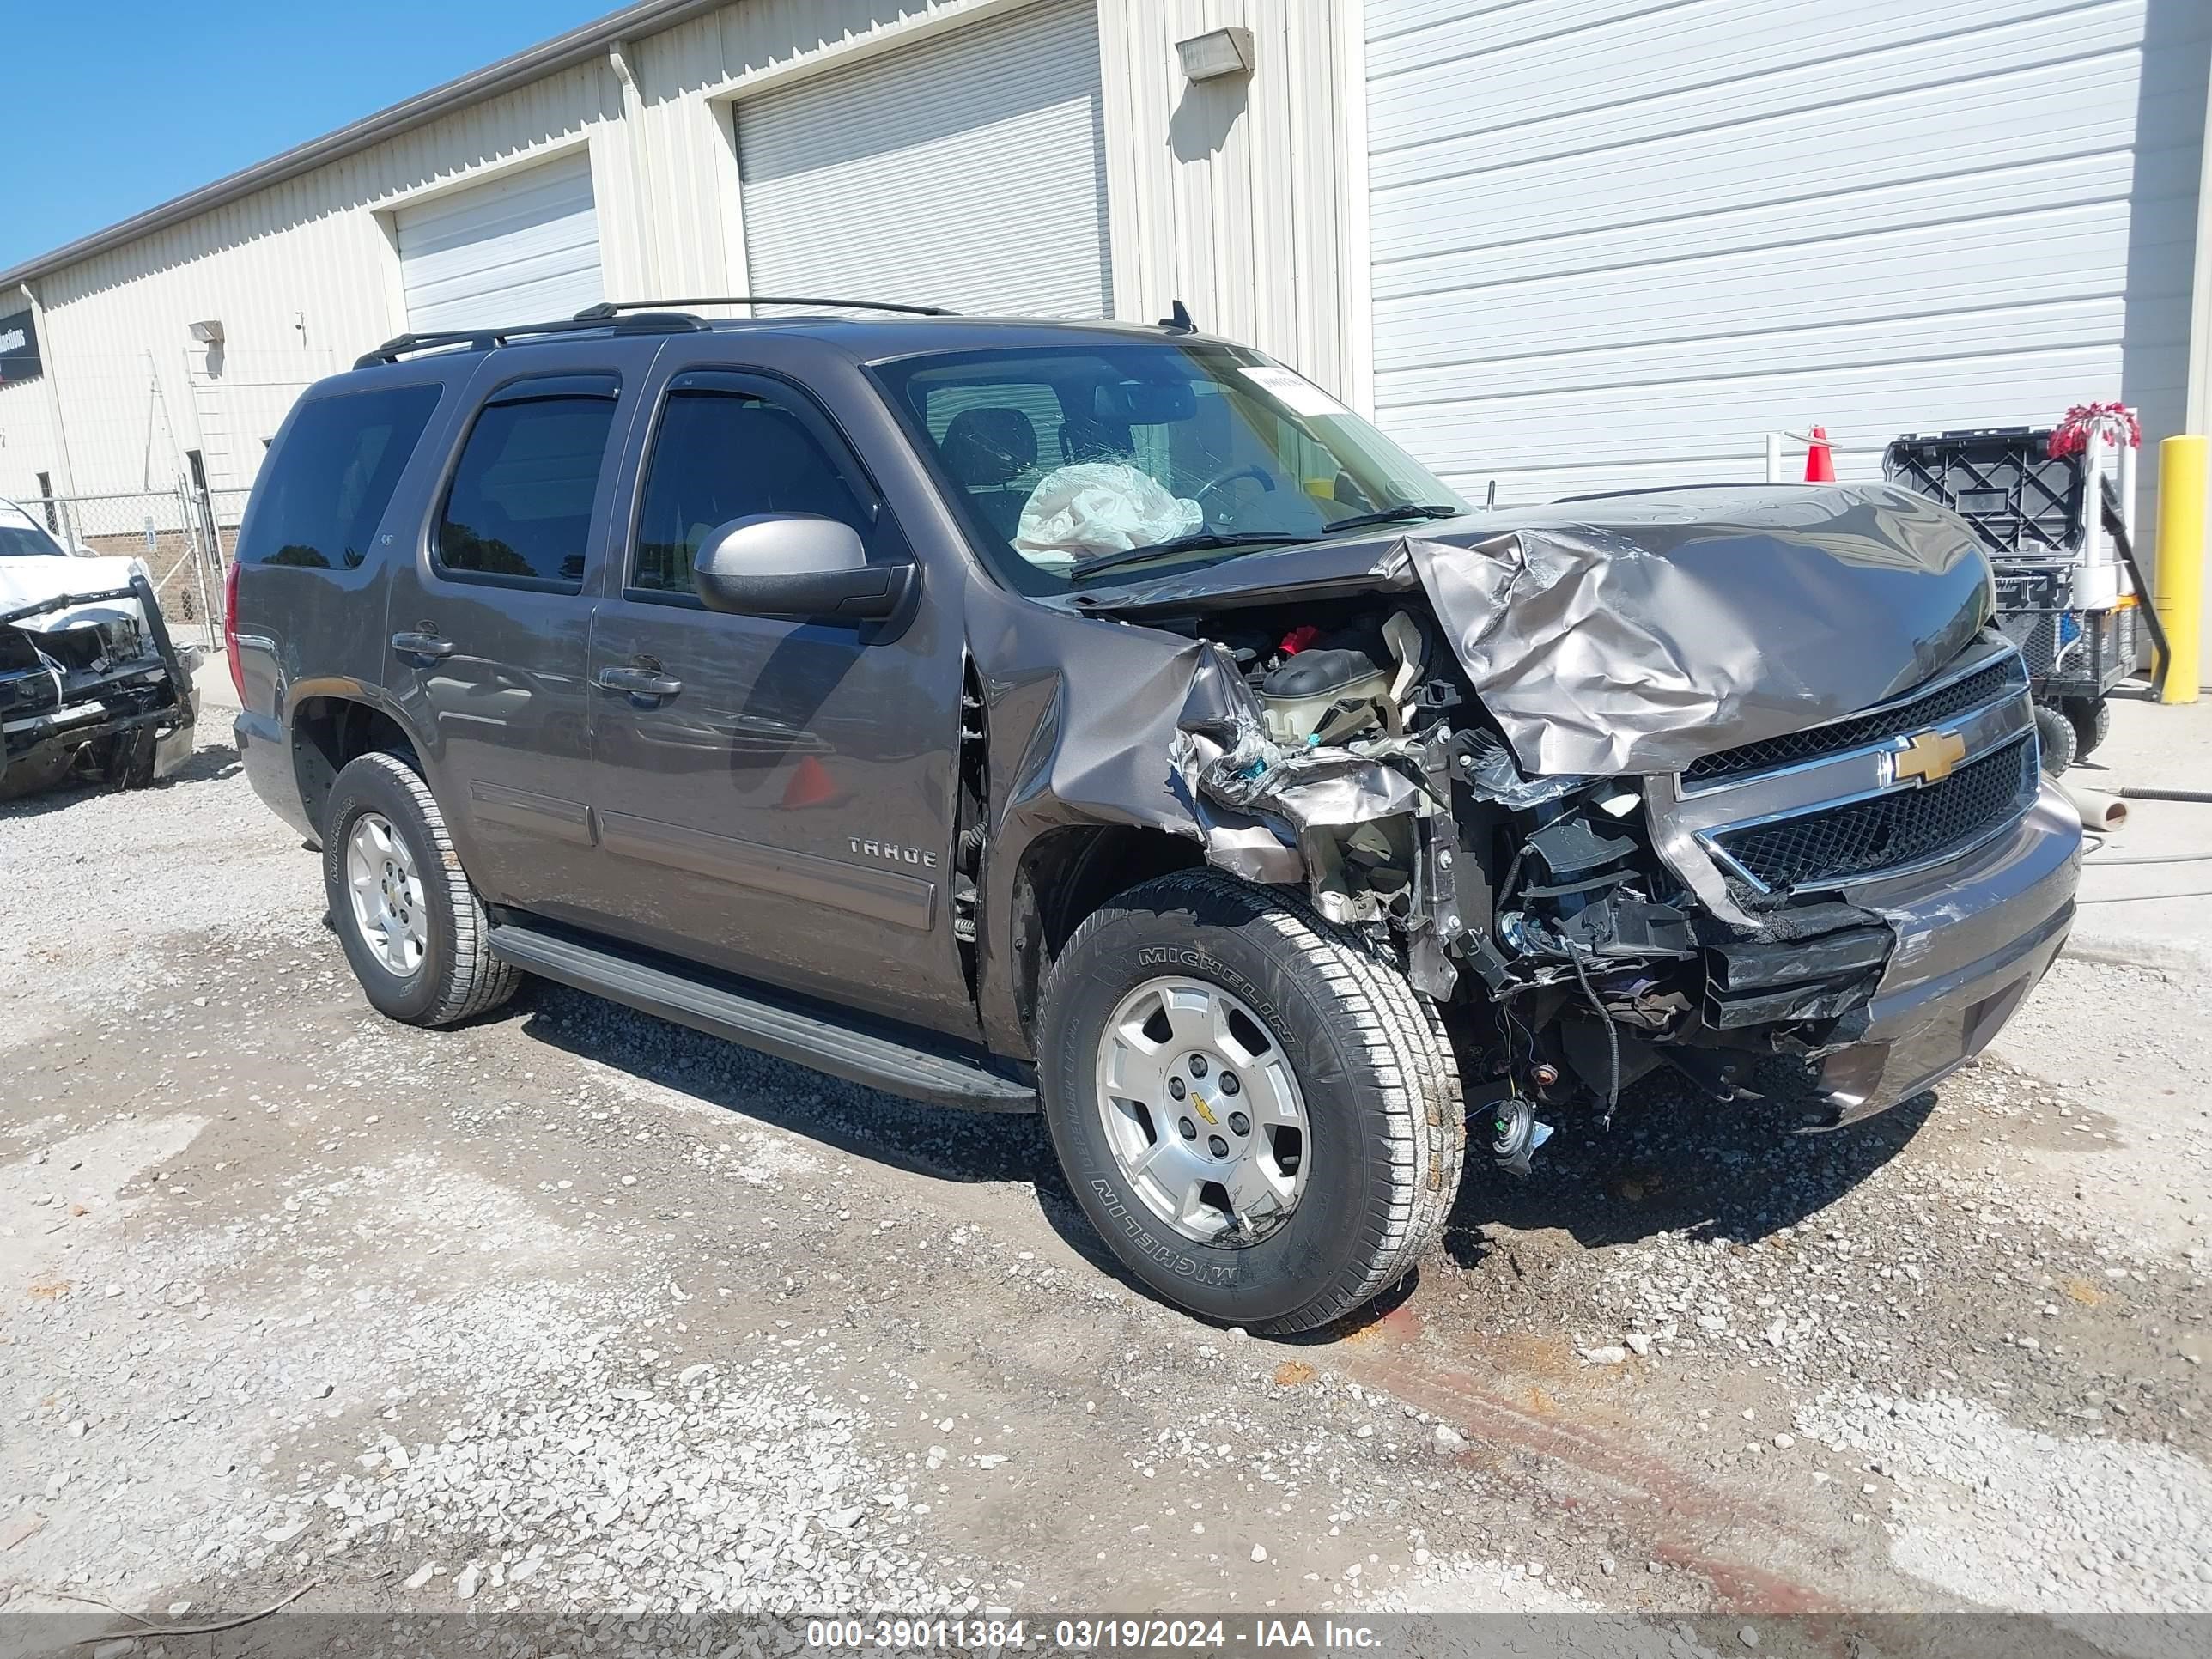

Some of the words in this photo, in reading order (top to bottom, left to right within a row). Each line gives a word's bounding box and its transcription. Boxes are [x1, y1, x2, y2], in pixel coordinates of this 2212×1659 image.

[848, 836, 937, 868] TAHOE
[1138, 947, 1295, 1044] MICHELIN
[1065, 1079, 1096, 1168] DEFENDER
[1091, 1178, 1241, 1285] MICHELIN
